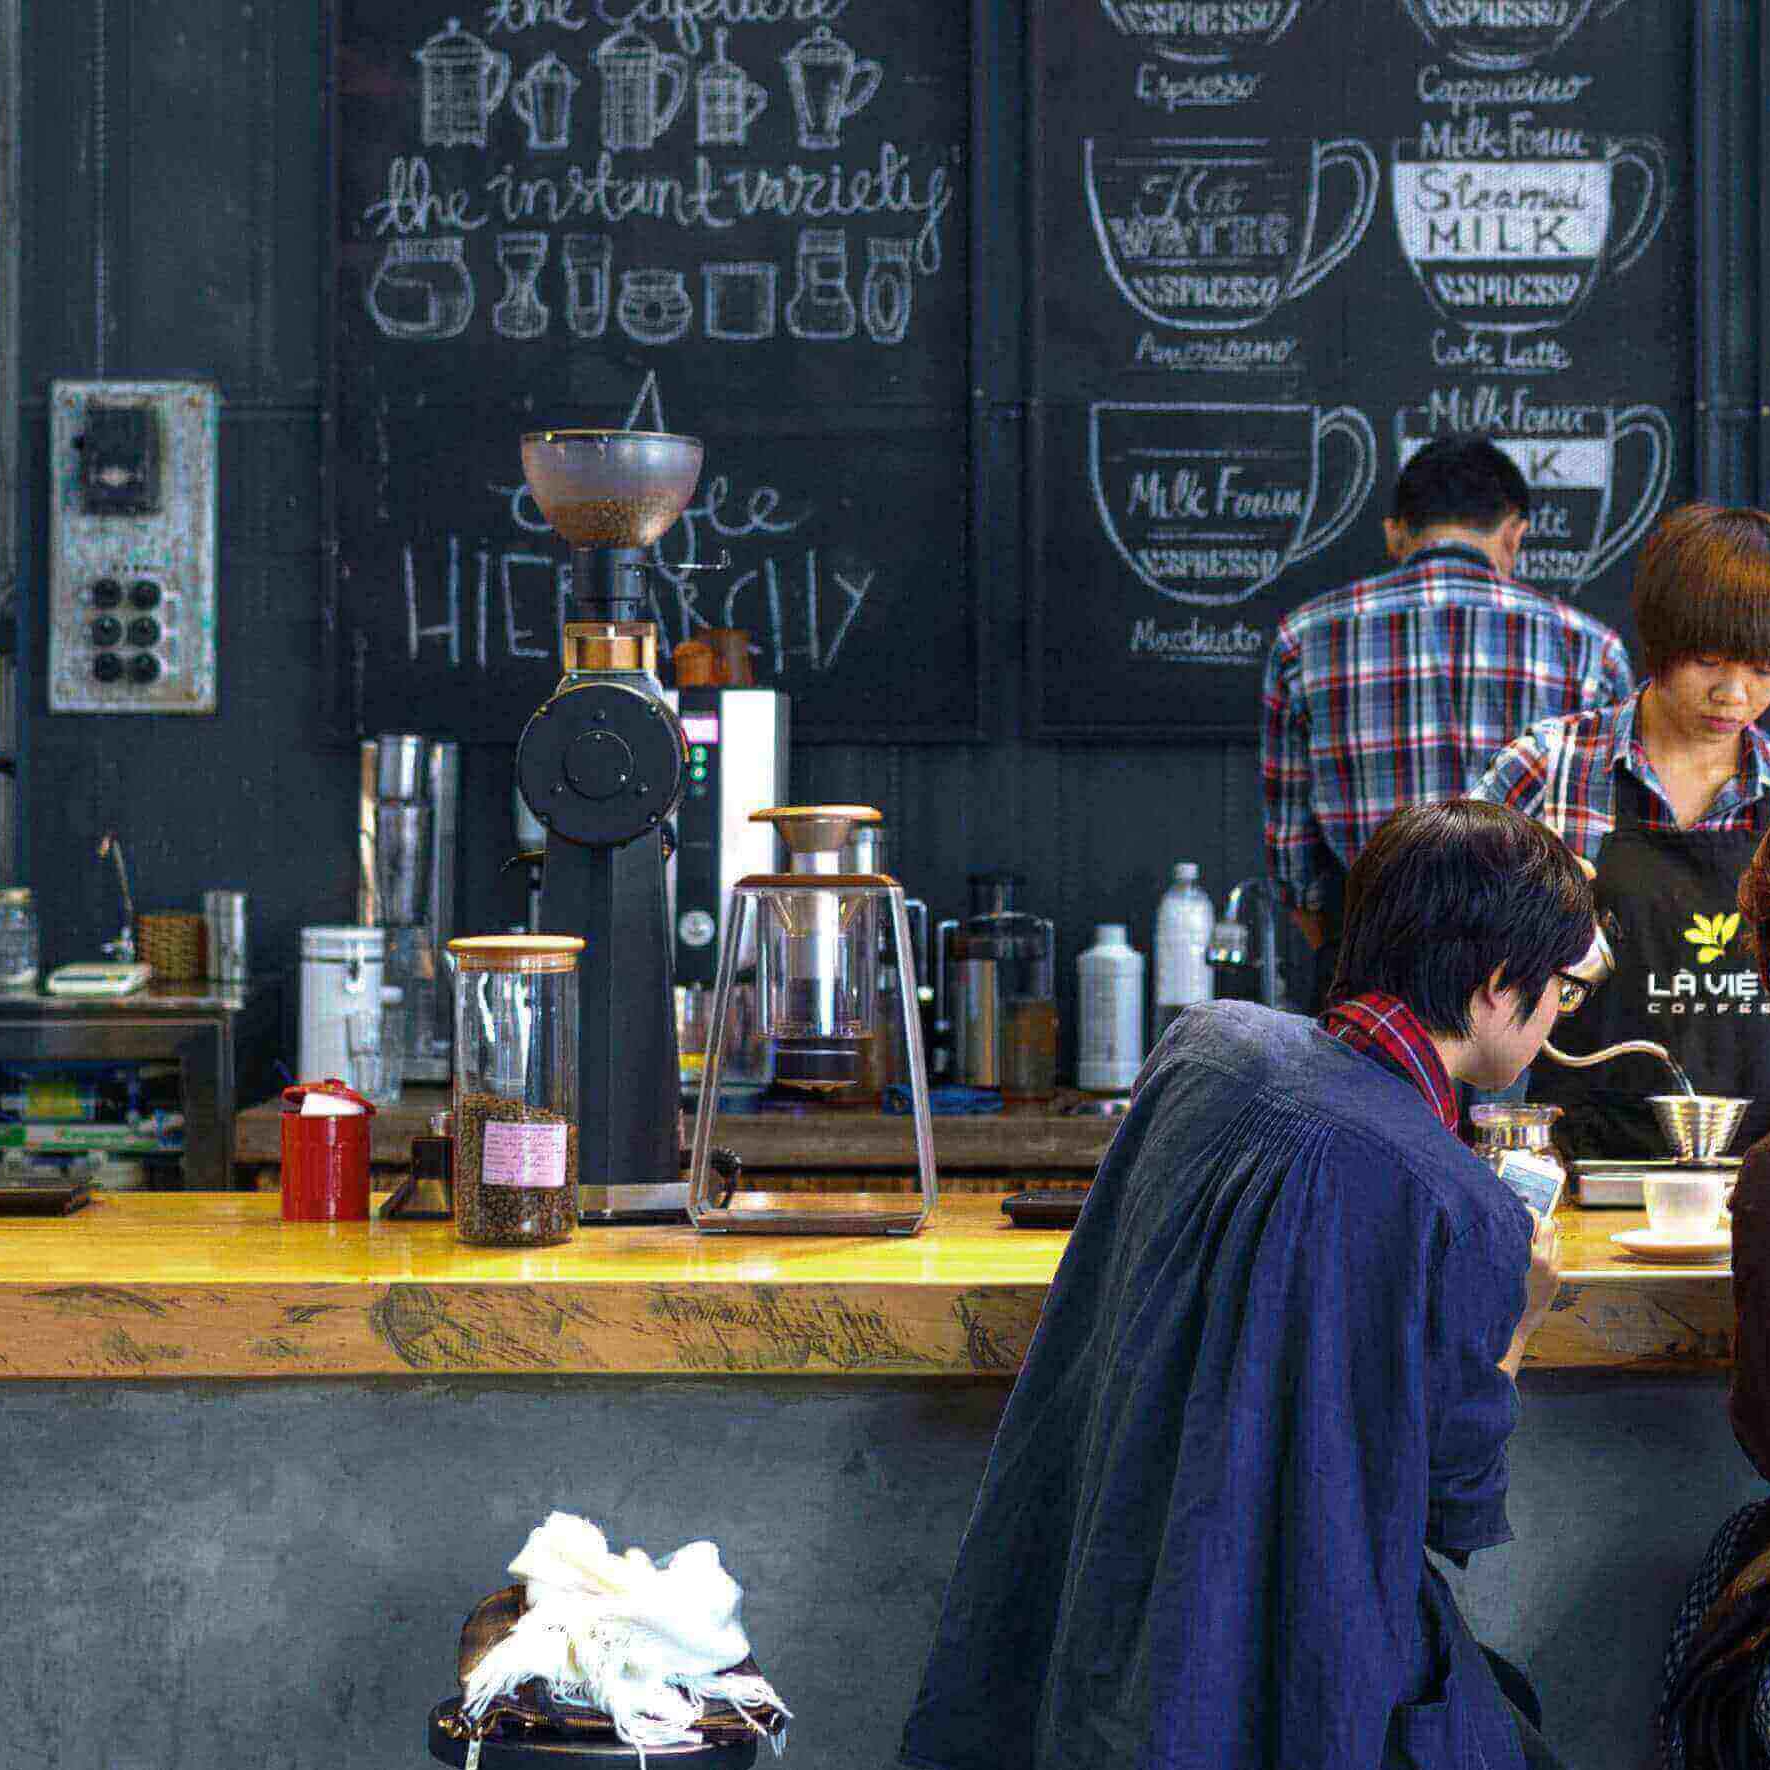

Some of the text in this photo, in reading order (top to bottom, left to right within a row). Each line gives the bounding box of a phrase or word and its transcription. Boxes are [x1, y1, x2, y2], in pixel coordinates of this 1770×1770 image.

[364, 142, 954, 275] the instant variety
[1107, 214, 1292, 258] WATER
[1428, 214, 1570, 252] MILK
[1128, 274, 1279, 307] ESPRESSO
[1434, 272, 1582, 306] ESPRESSO
[1128, 468, 1210, 520] Milk
[1704, 969, 1760, 1001] VIỆ
